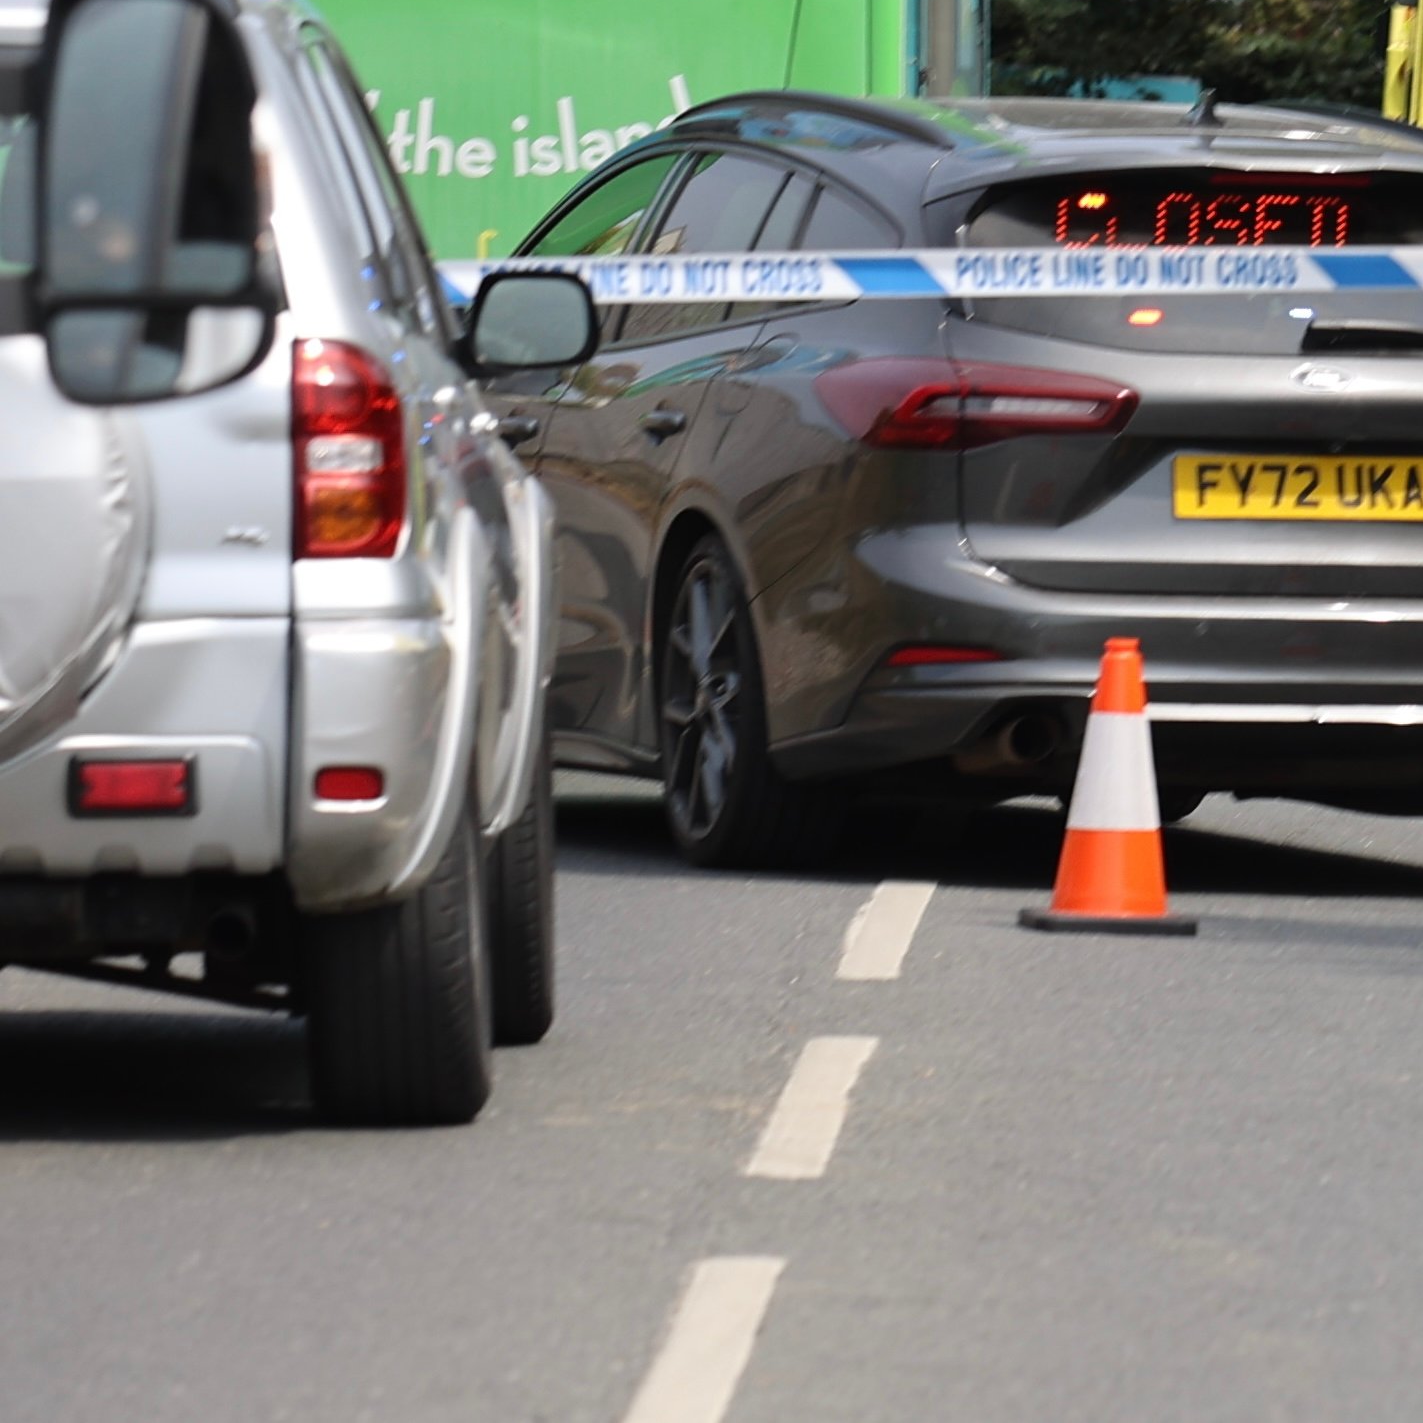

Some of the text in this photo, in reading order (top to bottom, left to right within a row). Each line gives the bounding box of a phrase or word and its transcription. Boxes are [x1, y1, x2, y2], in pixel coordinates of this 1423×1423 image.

[387, 97, 497, 178] the
[641, 261, 672, 296] DO
[683, 260, 731, 295] NOT
[742, 259, 823, 294] CROSS
[955, 252, 1299, 291] POLICE LINE DO NOT CROSS
[1196, 464, 1319, 509] FY72
